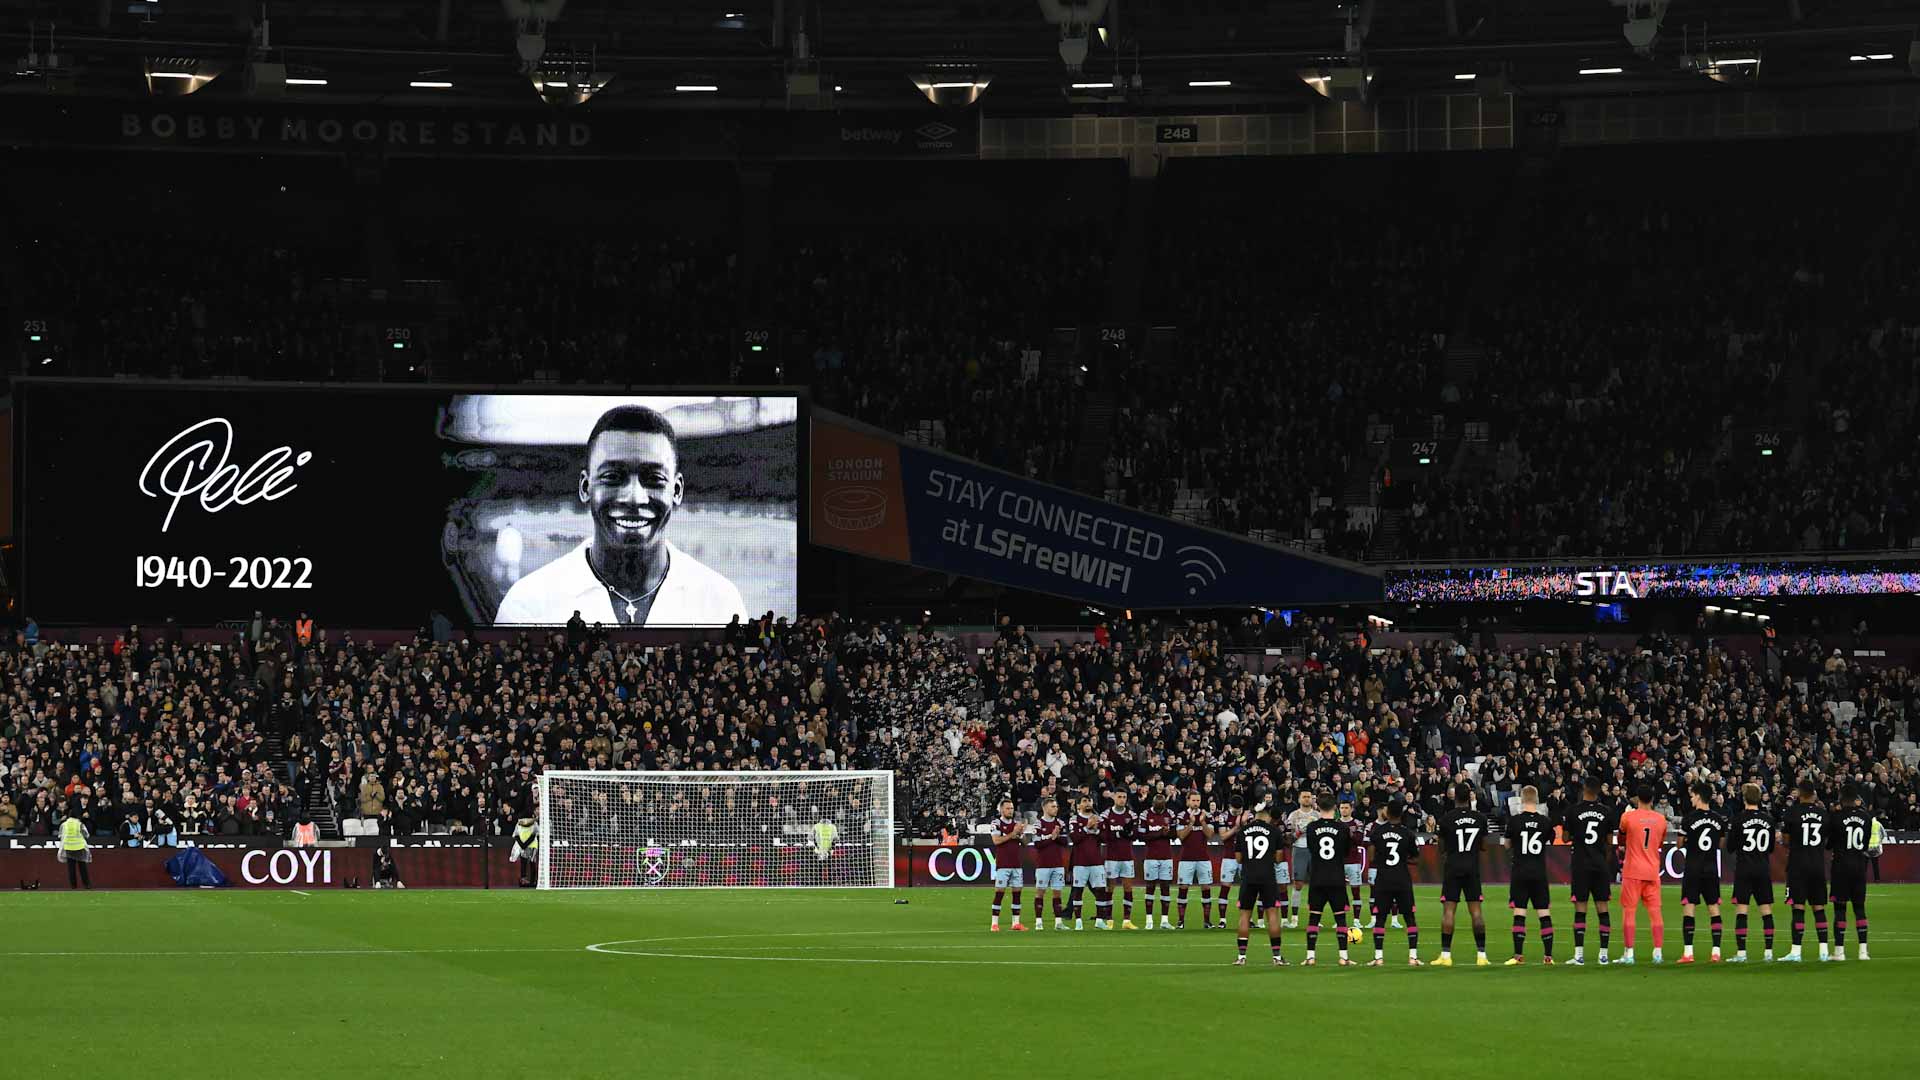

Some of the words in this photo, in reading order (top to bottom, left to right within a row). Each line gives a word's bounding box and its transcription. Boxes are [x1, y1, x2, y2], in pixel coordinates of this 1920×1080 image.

[121, 112, 266, 141] BOBBY
[280, 118, 437, 145] MOORE
[451, 121, 592, 147] STAND
[841, 128, 902, 144] betway
[1163, 128, 1191, 139] 248
[24, 320, 48, 332] 251
[386, 328, 410, 339] 250
[744, 330, 768, 342] 249
[1101, 329, 1126, 340] 248
[1412, 442, 1437, 454] 247
[1755, 433, 1780, 446] 246
[827, 458, 883, 469] LONDON
[827, 471, 883, 480] STADIUM
[926, 469, 994, 511] STAY
[998, 490, 1163, 560] CONNECTED
[941, 518, 971, 546] at
[973, 523, 1132, 595] LSFreeWIFI
[136, 556, 313, 588] 1940-2022
[1578, 811, 1605, 821] PINNOCK
[1801, 812, 1822, 821] ZANKA
[1243, 826, 1270, 835] MBEUMO
[1315, 826, 1338, 835] JENSEN
[1382, 832, 1402, 840] HENRY
[1456, 828, 1480, 852] 17
[1584, 821, 1599, 845] 5
[1643, 828, 1650, 849] 1
[1698, 828, 1712, 851] 6
[1742, 829, 1770, 852] 30
[1801, 823, 1822, 846] 13
[1846, 826, 1864, 850] 10
[1245, 836, 1269, 859] 19
[1319, 836, 1335, 860] 8
[1520, 831, 1543, 854] 16
[928, 848, 997, 881] COY
[1385, 842, 1400, 866] 3
[241, 850, 331, 884] COYI
